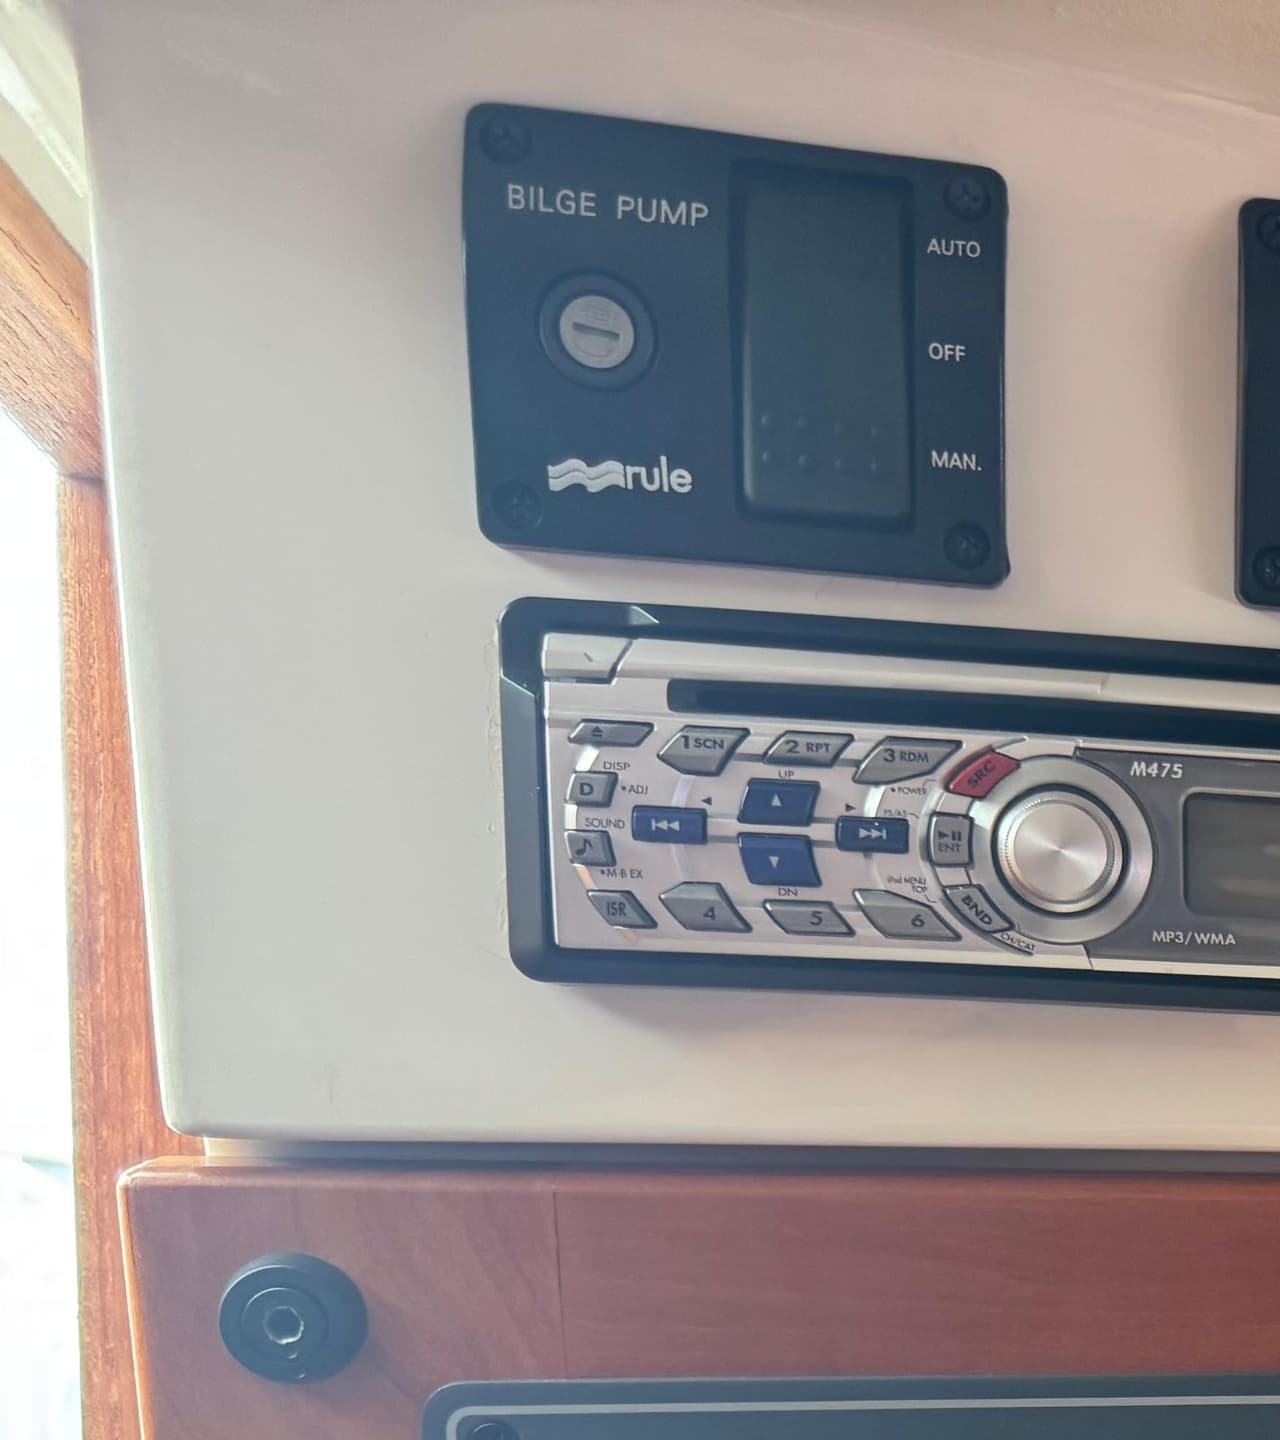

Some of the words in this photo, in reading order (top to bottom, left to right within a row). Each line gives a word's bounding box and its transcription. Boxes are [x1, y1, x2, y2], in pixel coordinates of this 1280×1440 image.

[507, 183, 597, 216] BILGE
[617, 195, 709, 227] PUMP
[927, 238, 981, 258] AUTO
[928, 342, 966, 362] OFF
[931, 450, 982, 472] MAN.
[625, 455, 693, 493] rule
[694, 739, 724, 750] SCN
[806, 743, 831, 753] RPT
[900, 751, 928, 763] RDM
[967, 760, 996, 788] SRC
[1130, 761, 1183, 778] M475
[585, 818, 625, 828] SOUND
[1152, 931, 1236, 946] MP3/WMA
